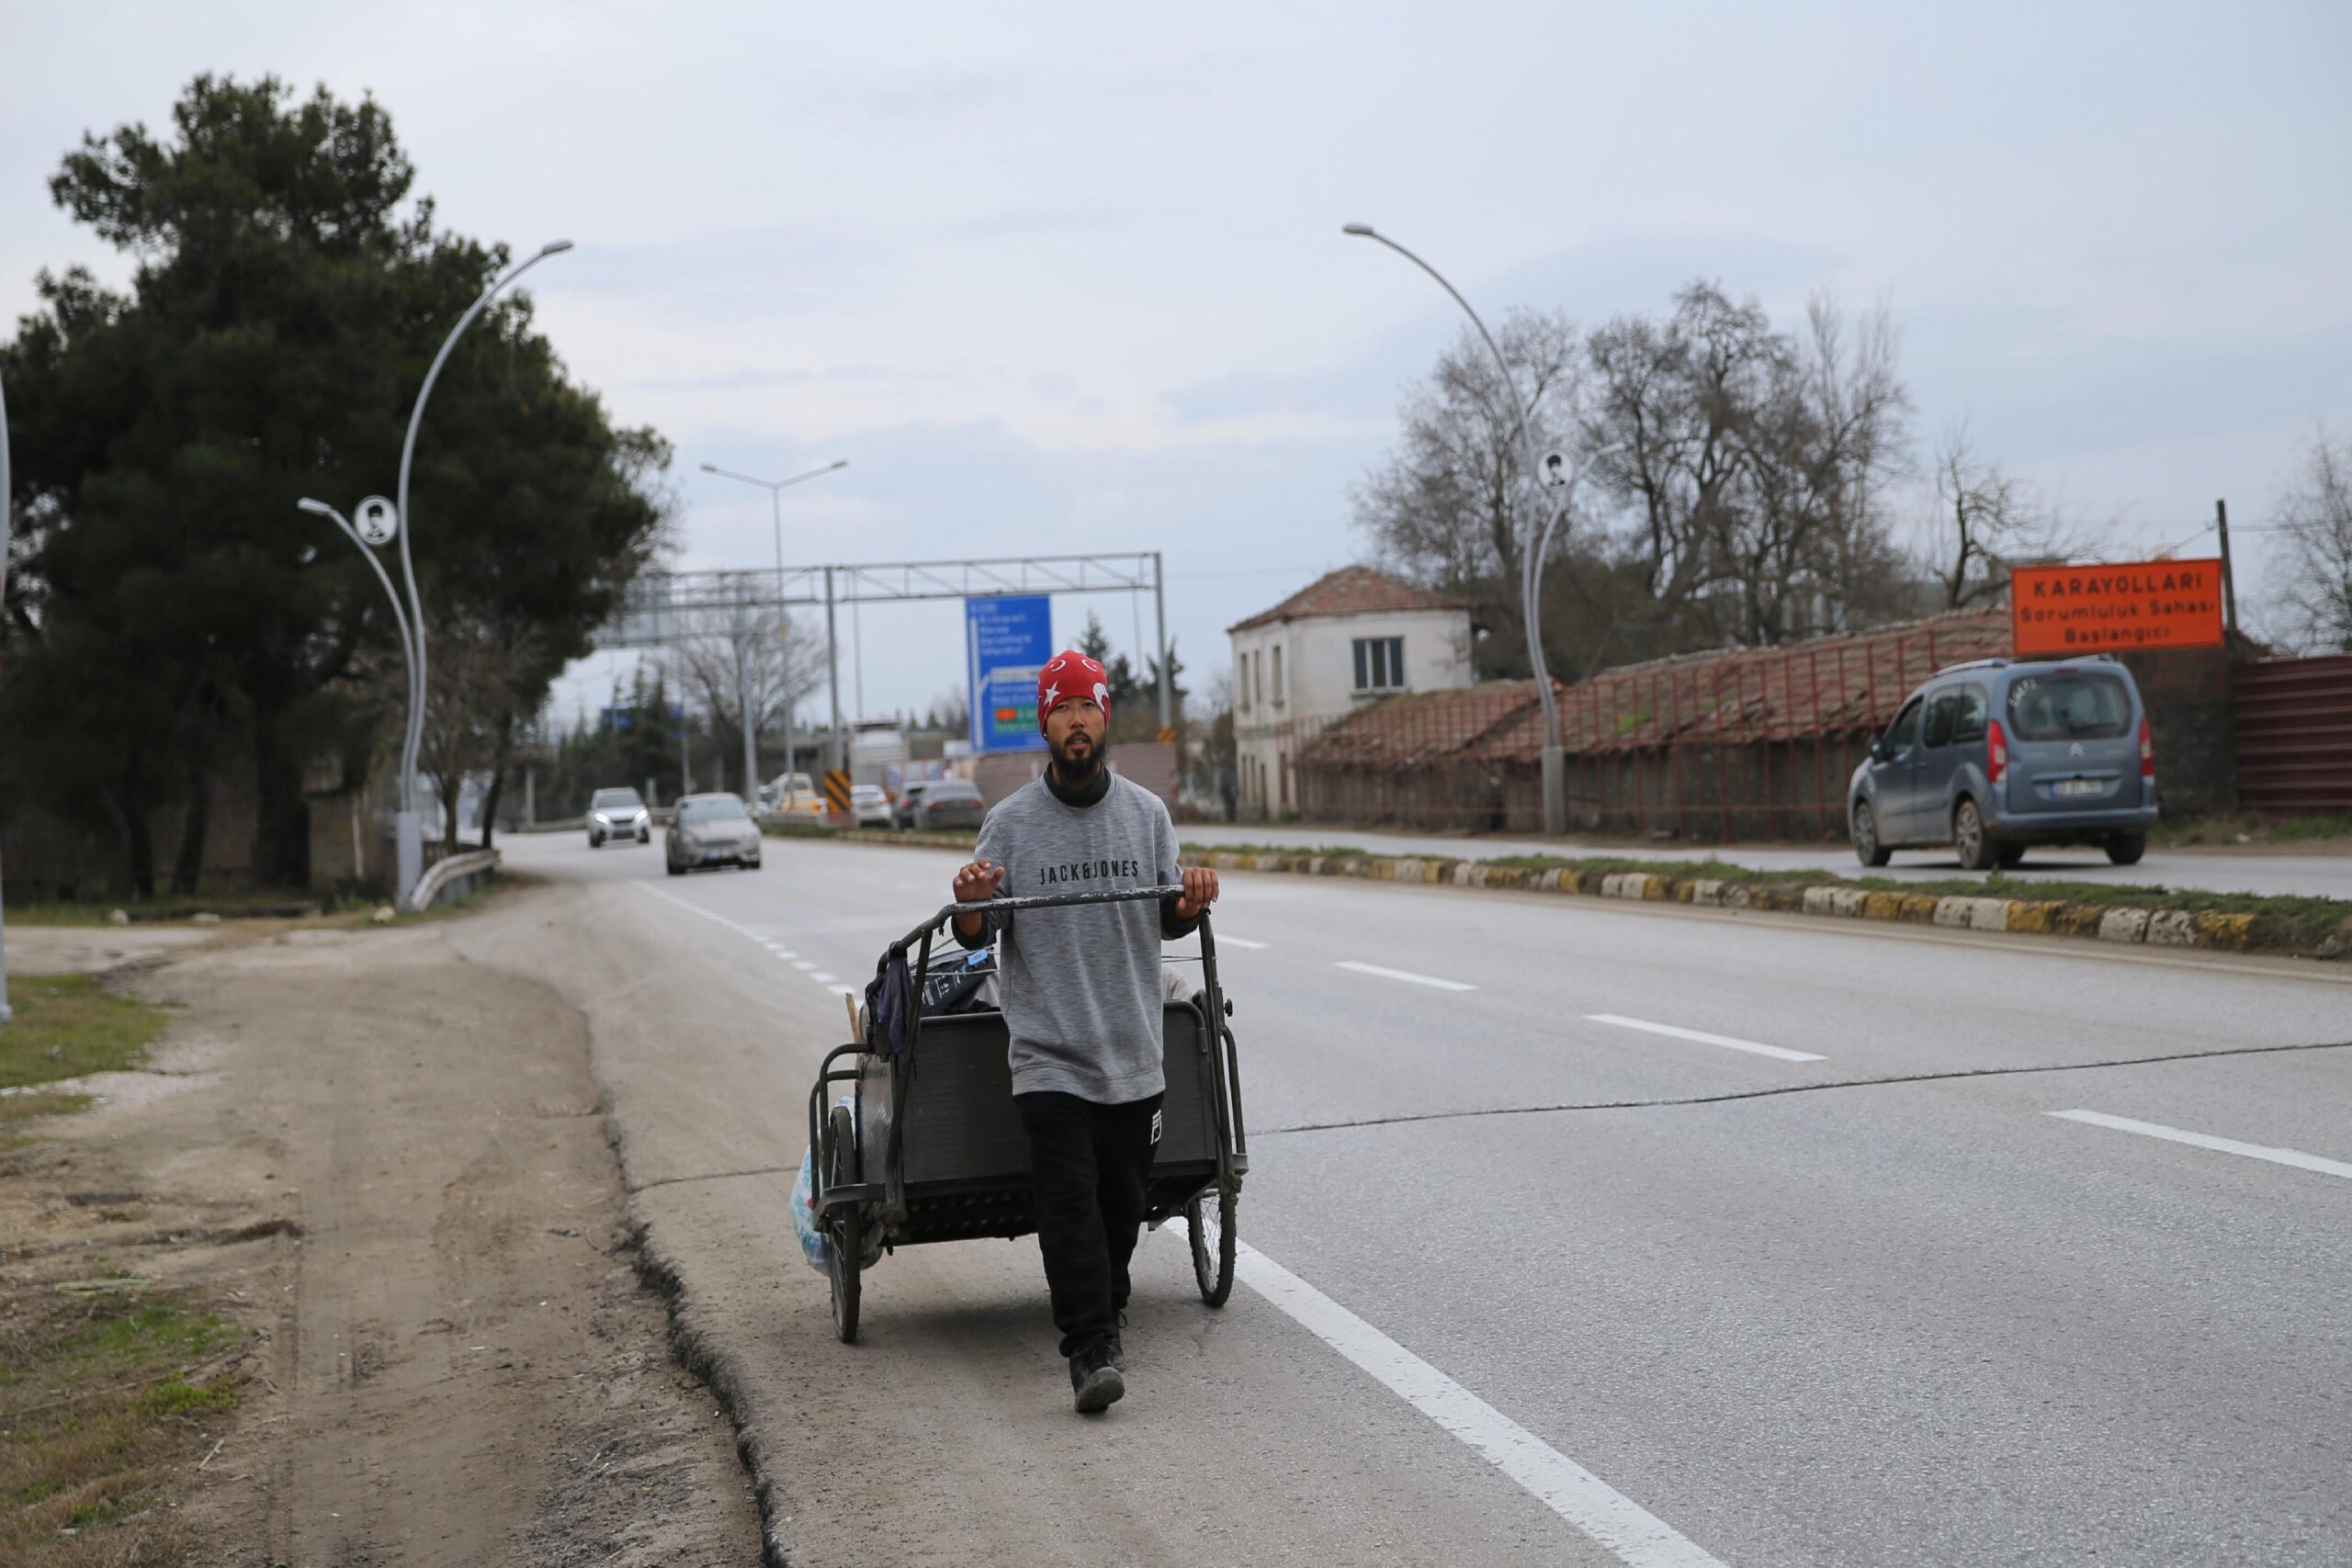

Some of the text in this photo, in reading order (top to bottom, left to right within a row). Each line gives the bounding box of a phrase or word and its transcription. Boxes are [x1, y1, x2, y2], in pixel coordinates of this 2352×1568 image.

[2033, 571, 2203, 598] KARAYOLLARI
[2021, 602, 2138, 623] Sorumluluk
[1039, 860, 1139, 886] JACK&JONES
